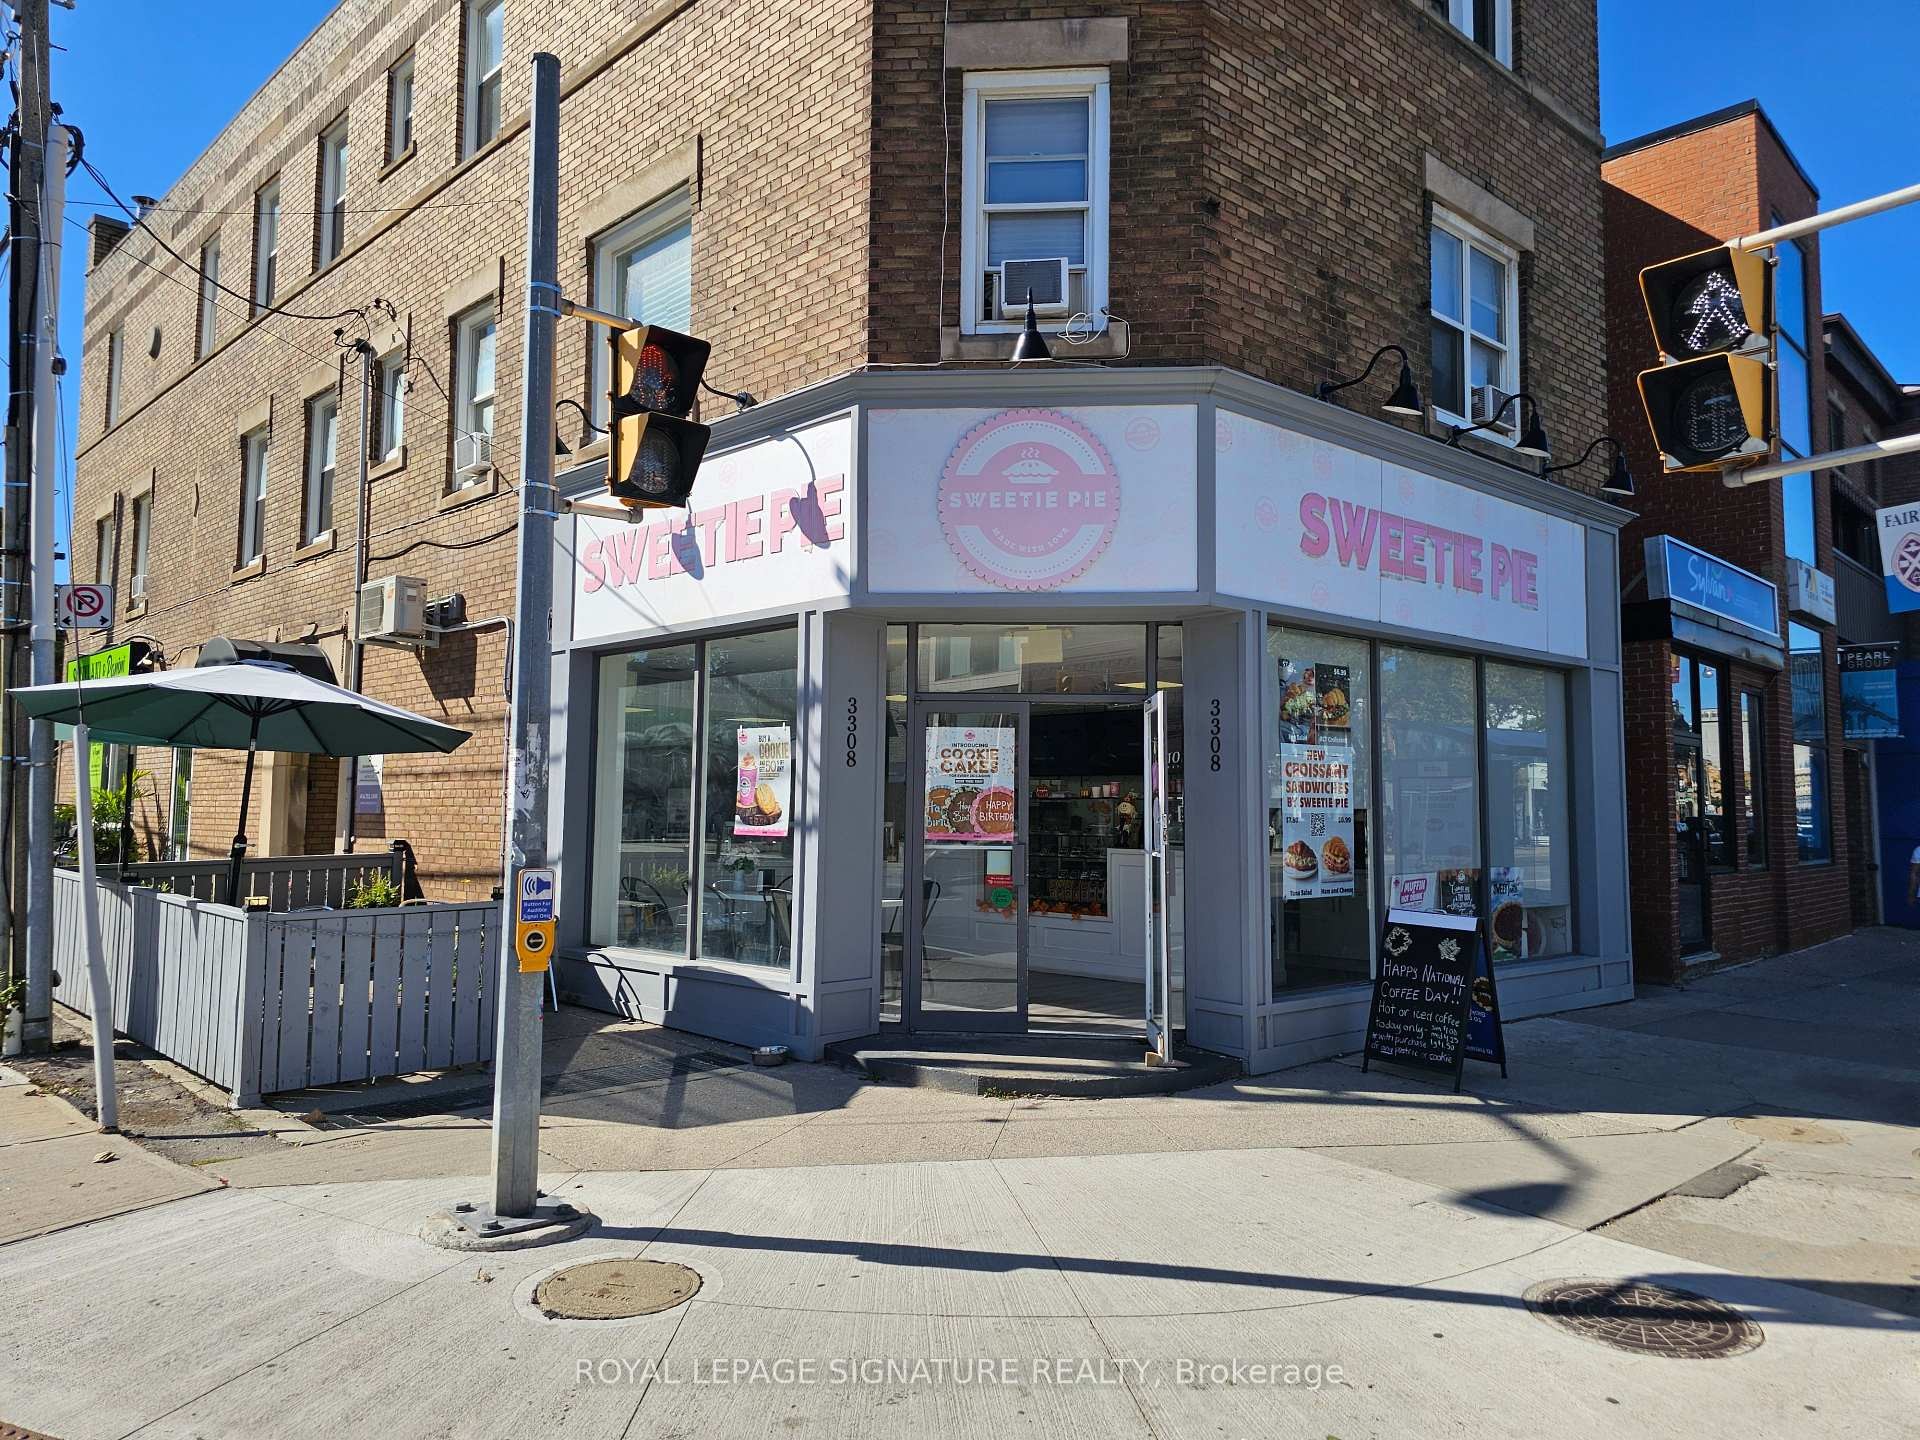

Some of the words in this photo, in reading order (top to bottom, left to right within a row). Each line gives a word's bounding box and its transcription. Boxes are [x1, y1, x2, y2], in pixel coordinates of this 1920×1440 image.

[949, 491, 1059, 509] SWEETIE
[1068, 490, 1107, 508] PIE
[582, 494, 764, 594] SWEETIE
[769, 473, 845, 555] PIE
[1299, 492, 1483, 593] SWEETIE
[1490, 542, 1539, 611] PIE
[1846, 651, 1891, 661] PEARL
[1847, 658, 1891, 669] GROUP
[846, 696, 858, 768] 3308
[1210, 698, 1221, 772] 3308
[759, 742, 789, 759] COOKIE
[941, 748, 999, 760] COOKIE
[1307, 749, 1326, 761] NEW
[941, 760, 999, 774] CAKES
[1285, 762, 1349, 779] CROISSANT
[1286, 780, 1349, 794] SANDWICHES
[985, 801, 1012, 811] HAPPY
[1299, 797, 1333, 808] SWEETIE
[1335, 798, 1349, 808] PIE
